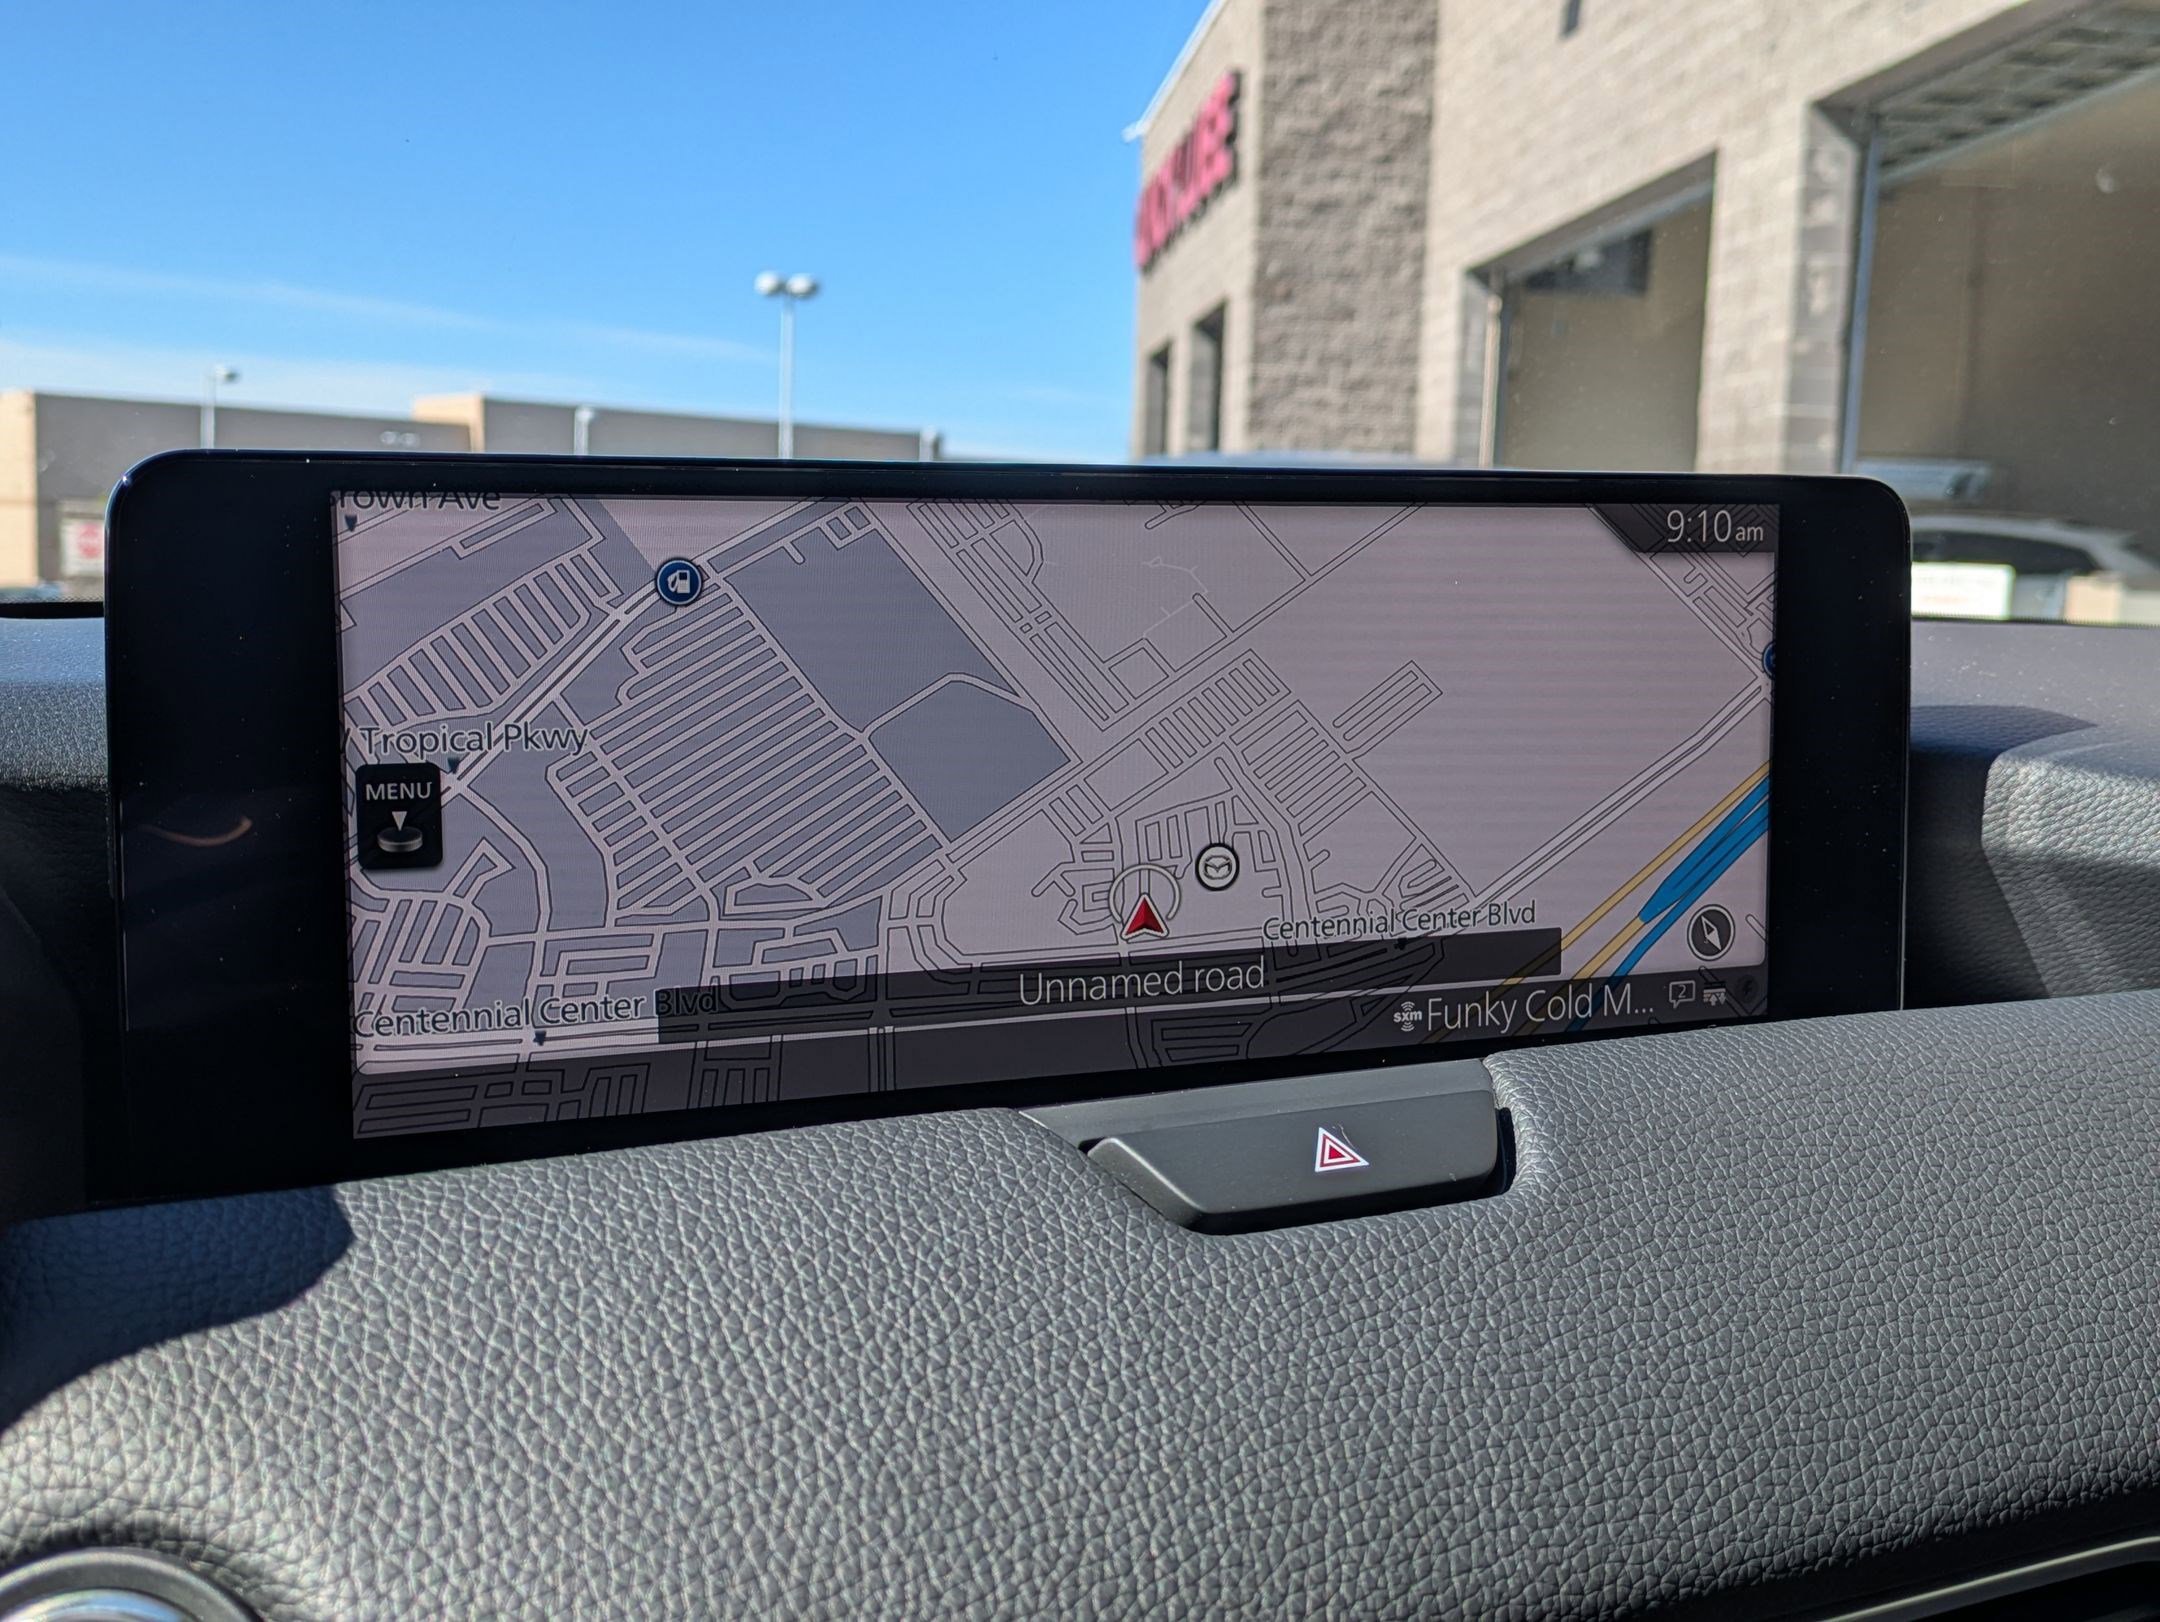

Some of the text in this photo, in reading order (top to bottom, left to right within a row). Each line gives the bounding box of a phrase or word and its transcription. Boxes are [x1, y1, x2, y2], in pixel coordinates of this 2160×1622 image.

[333, 490, 430, 509] rown
[360, 721, 493, 761] Tropical
[503, 721, 588, 756] Pkwy
[365, 781, 433, 801] MENU
[1263, 900, 1536, 941] Centennial Center Blvd
[1018, 955, 1265, 1006] Unnamed road
[1678, 984, 1687, 999] 2
[354, 988, 718, 1038] Centennial Center Blvd
[1428, 990, 1517, 1034] Funky
[1526, 983, 1593, 1022] Cold
